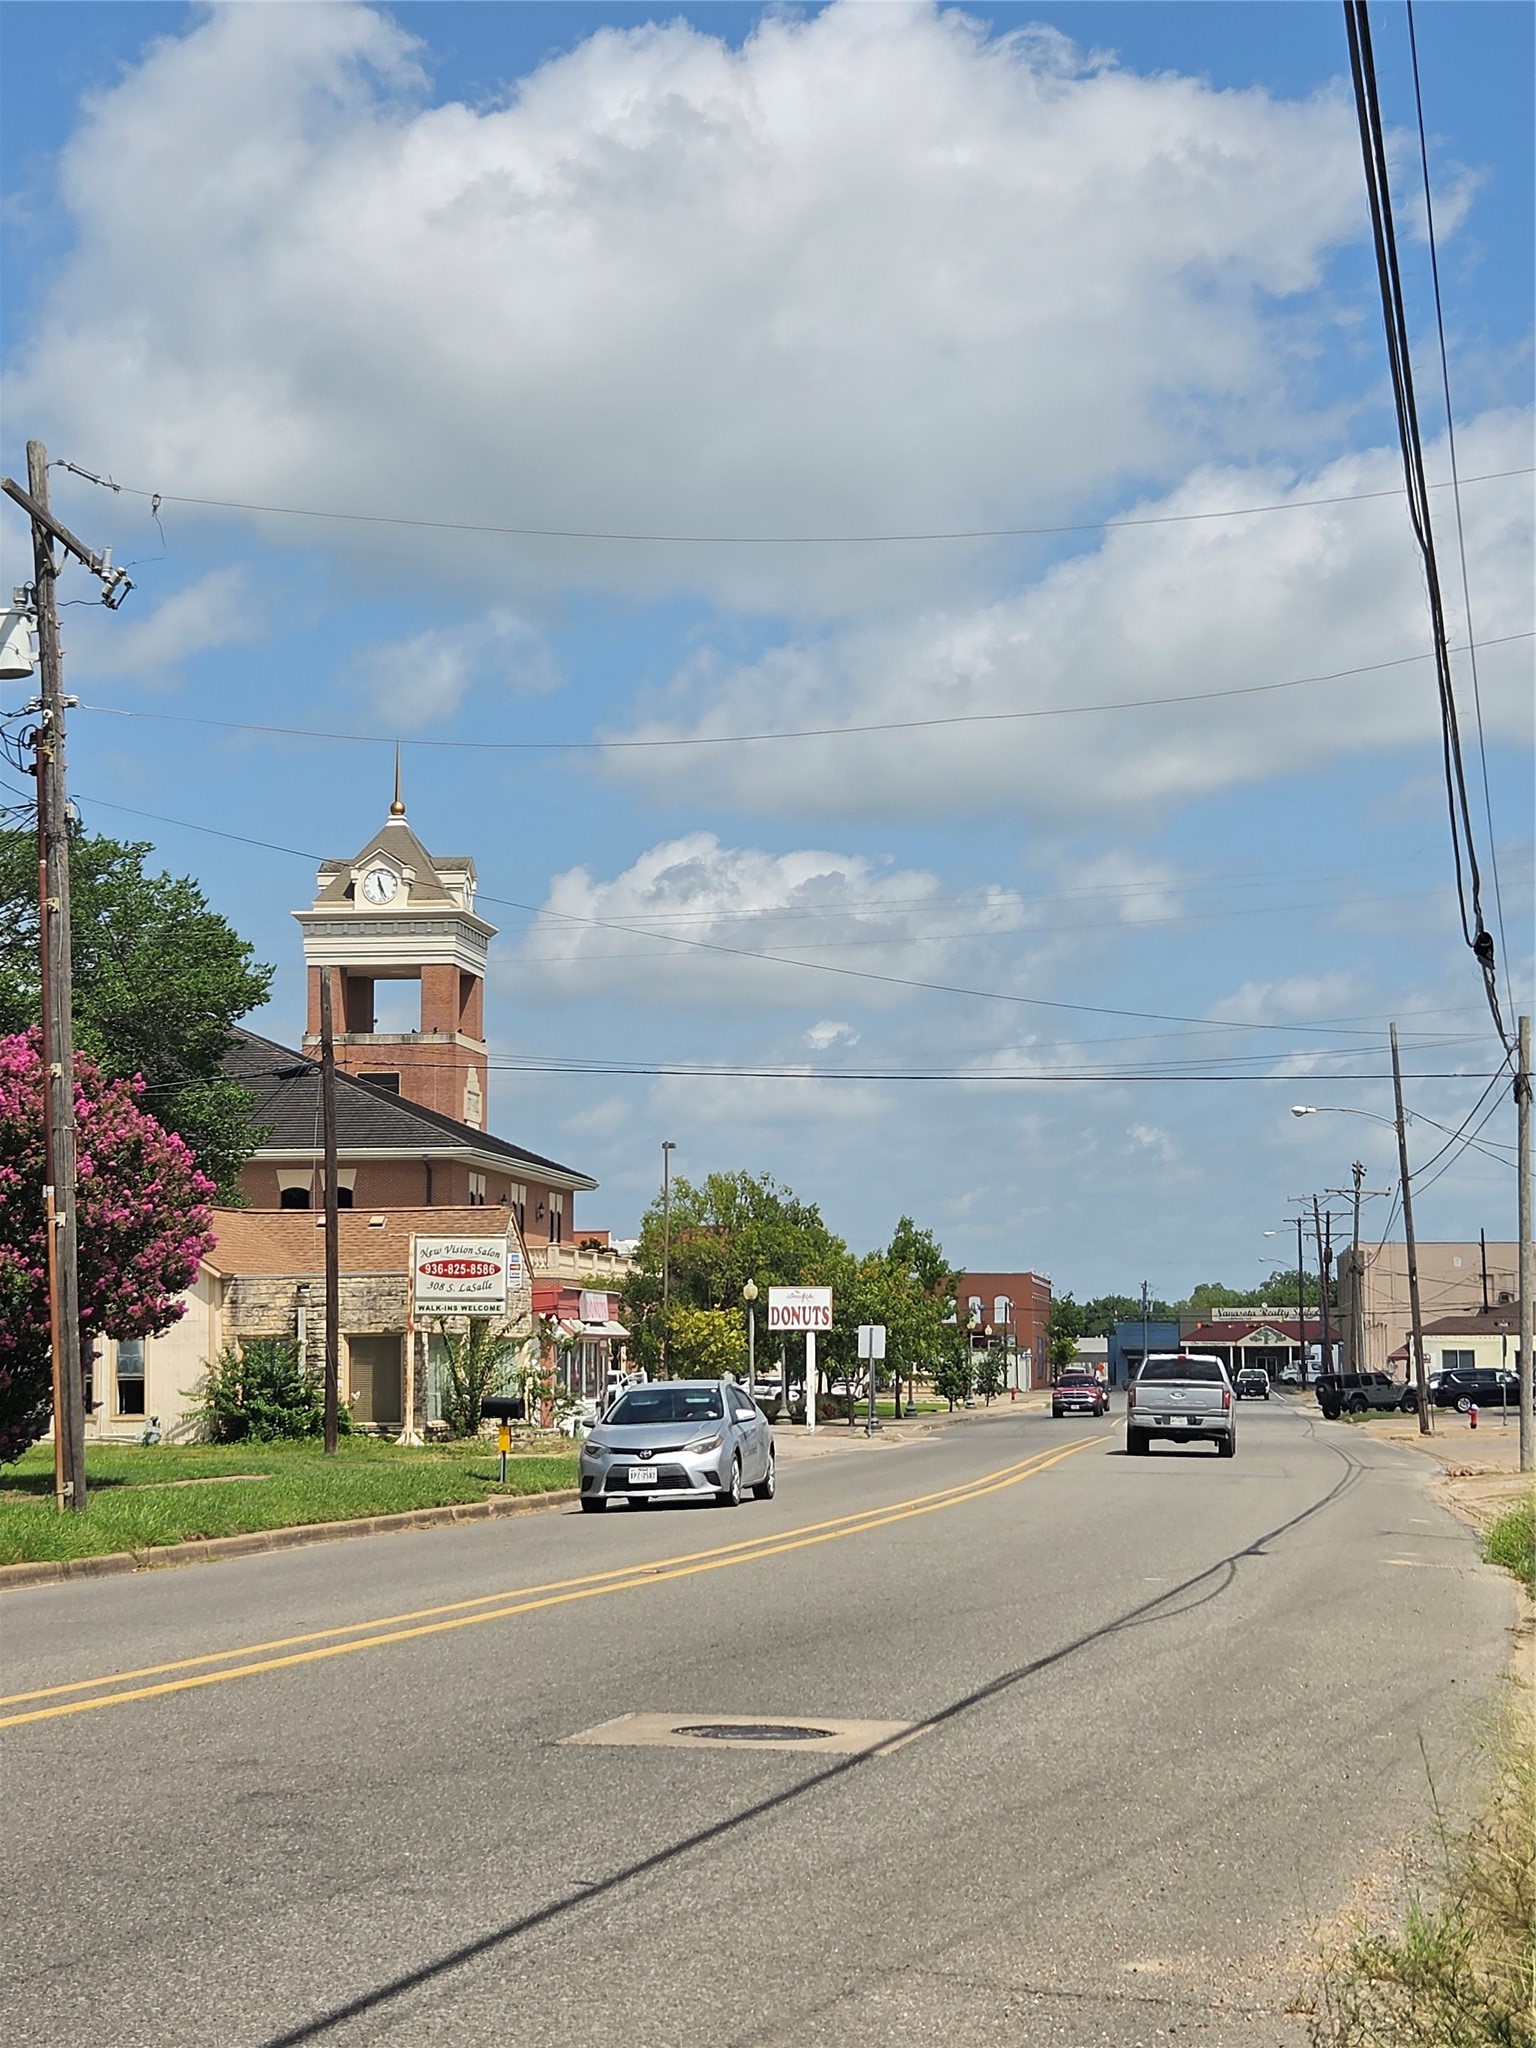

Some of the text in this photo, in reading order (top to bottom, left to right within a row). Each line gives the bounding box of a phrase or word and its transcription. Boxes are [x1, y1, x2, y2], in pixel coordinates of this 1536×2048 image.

[420, 1245, 501, 1259] New Vision Salon
[425, 1263, 496, 1275] 936-825-8586
[427, 1280, 493, 1293] 308 S. LaSalle
[770, 1306, 830, 1325] DONUTS
[1259, 1308, 1290, 1318] Realty
